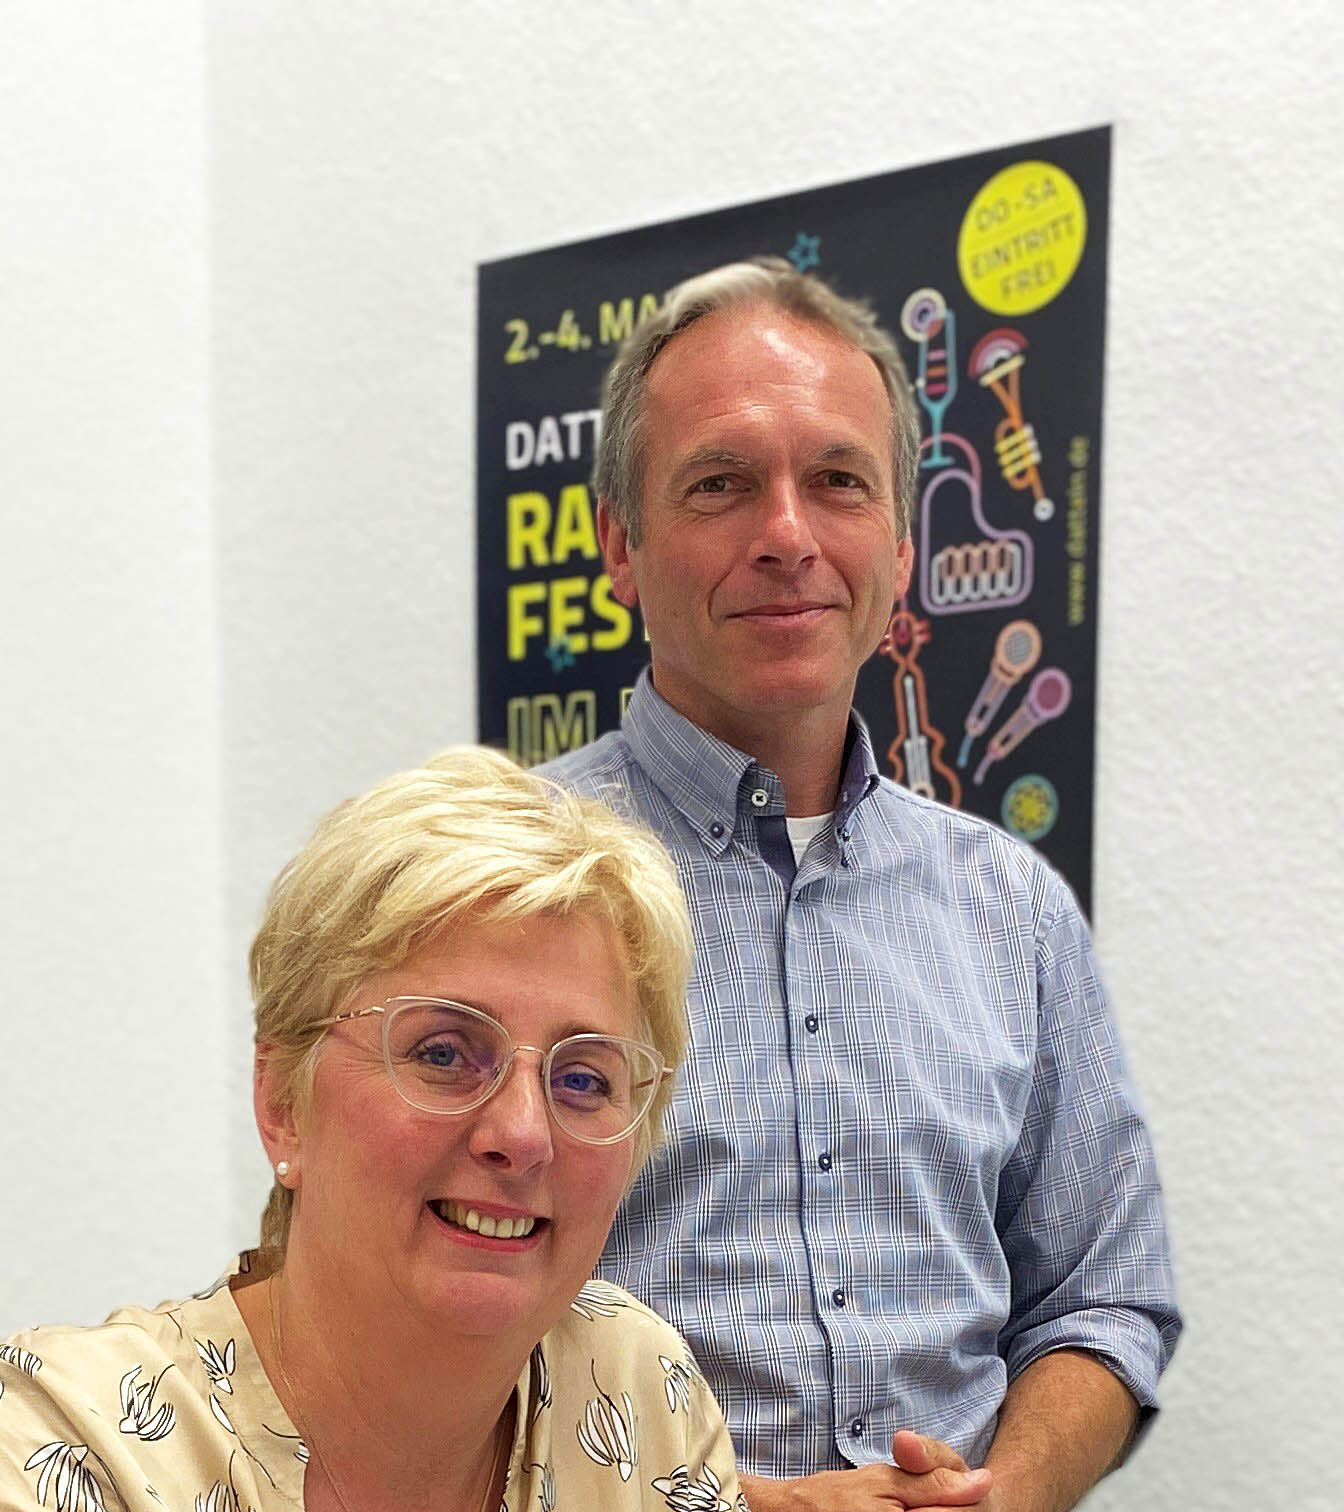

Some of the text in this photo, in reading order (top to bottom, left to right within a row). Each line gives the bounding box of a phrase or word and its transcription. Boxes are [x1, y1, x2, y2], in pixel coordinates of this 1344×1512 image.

[970, 211, 1075, 280] EINTRITT
[1000, 257, 1058, 299] FREI
[504, 293, 658, 364] 2.-4. MA
[505, 409, 604, 471] DATT
[507, 483, 600, 571] RA
[507, 573, 651, 661] FES
[508, 688, 598, 768] IM
